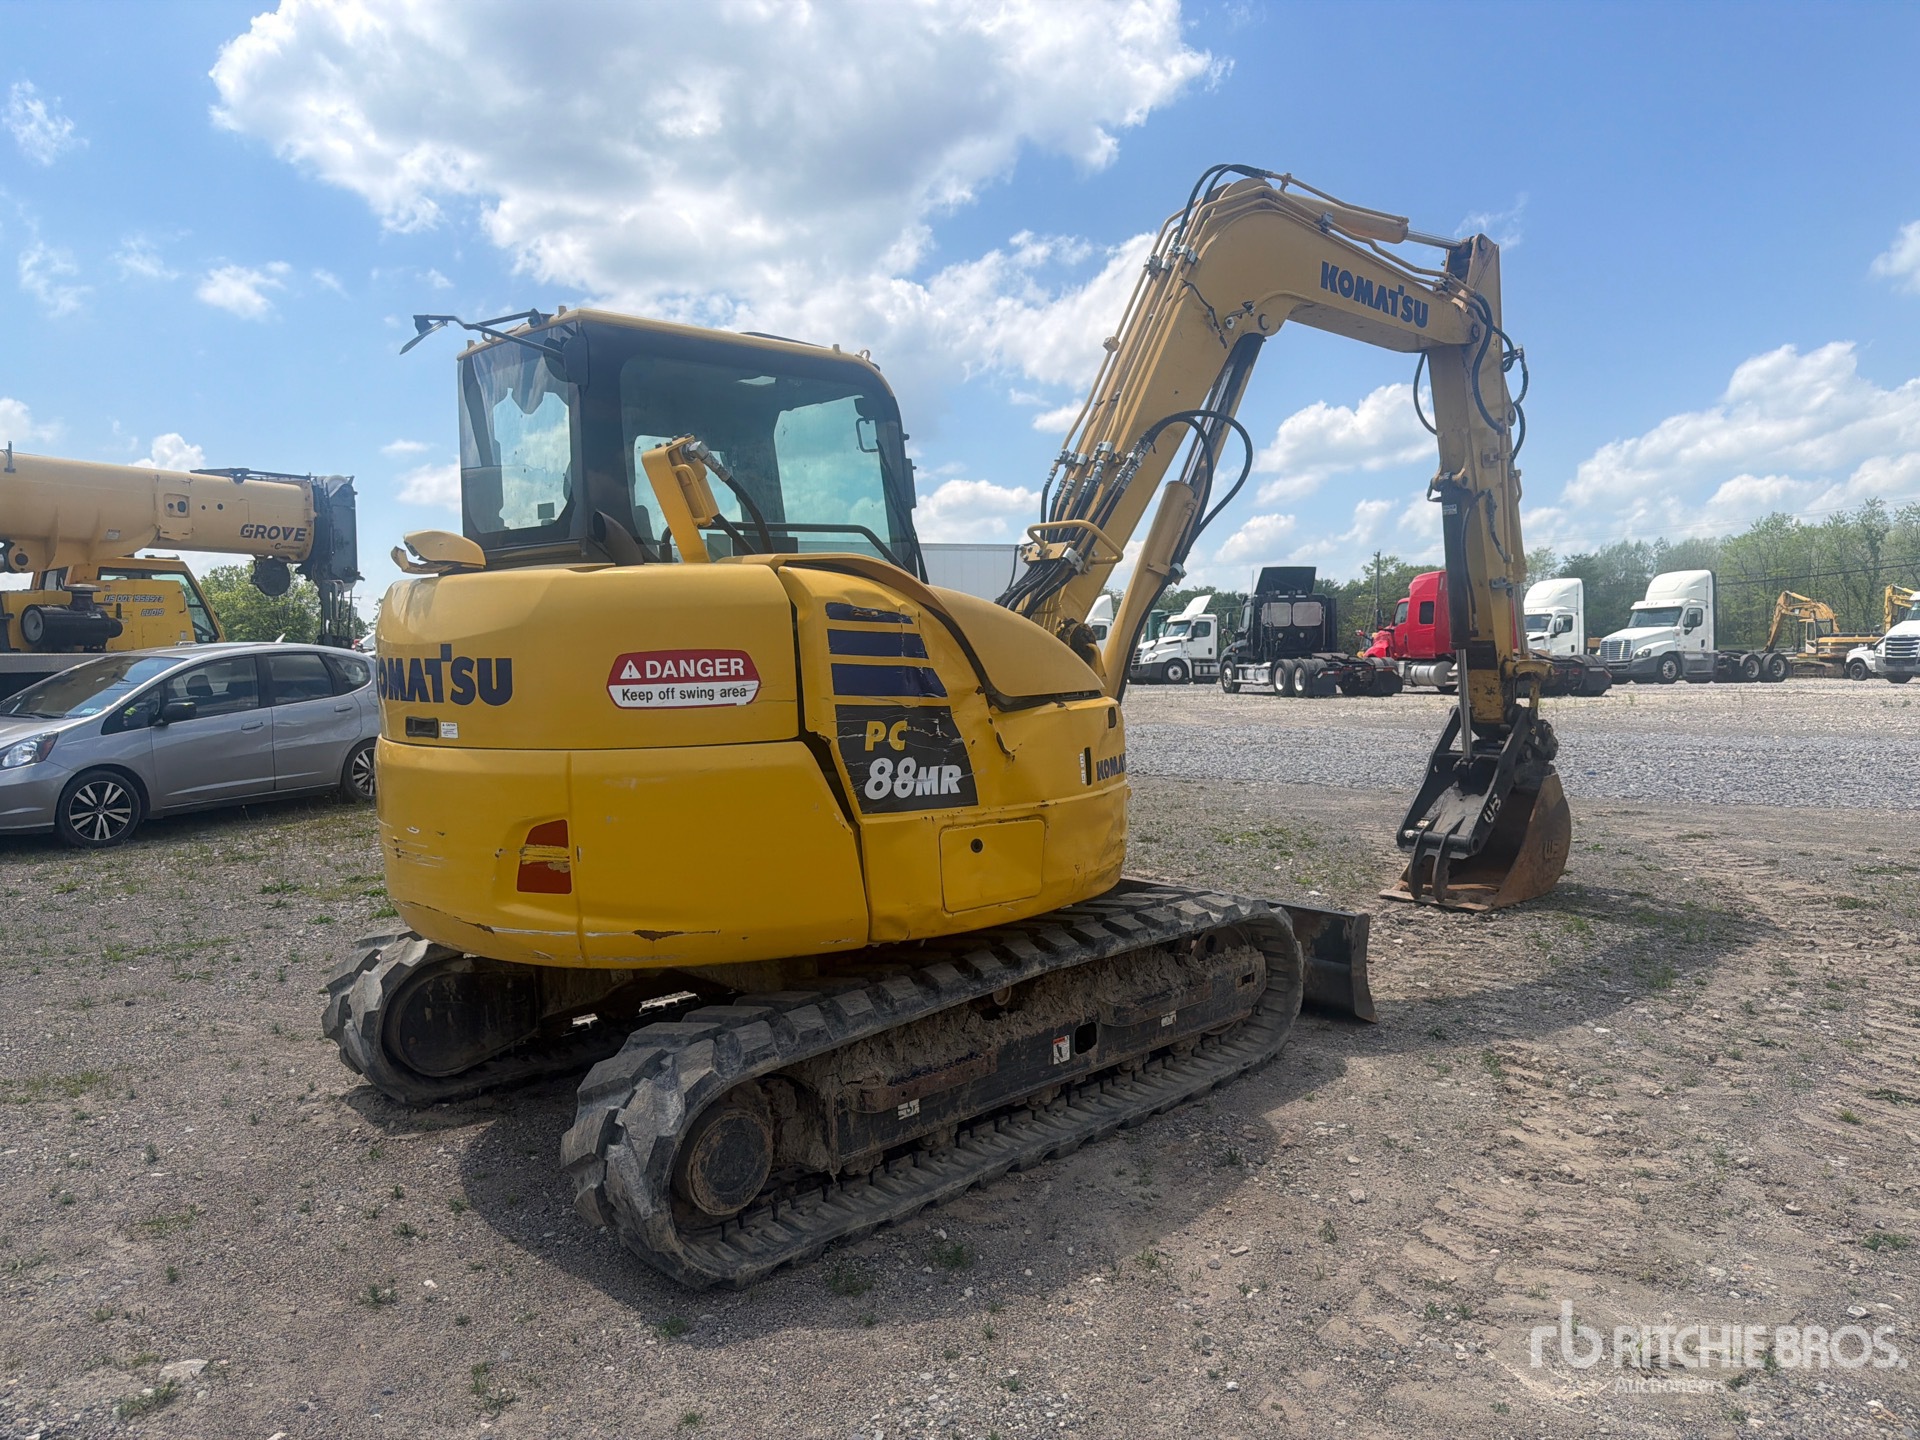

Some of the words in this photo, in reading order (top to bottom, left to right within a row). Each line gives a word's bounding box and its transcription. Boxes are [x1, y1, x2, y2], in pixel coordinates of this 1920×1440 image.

[1321, 261, 1428, 328] KOMATSU
[240, 523, 307, 541] GROVE
[104, 594, 116, 603] US
[116, 594, 133, 603] DOT
[378, 643, 513, 706] OMATSU
[645, 658, 745, 679] DANGER
[621, 688, 653, 703] Keep
[658, 687, 675, 700] off
[679, 686, 715, 700] swing
[720, 687, 747, 698] area
[865, 720, 908, 751] PC
[864, 757, 962, 800] 88MR
[1096, 753, 1126, 781] KOMA
